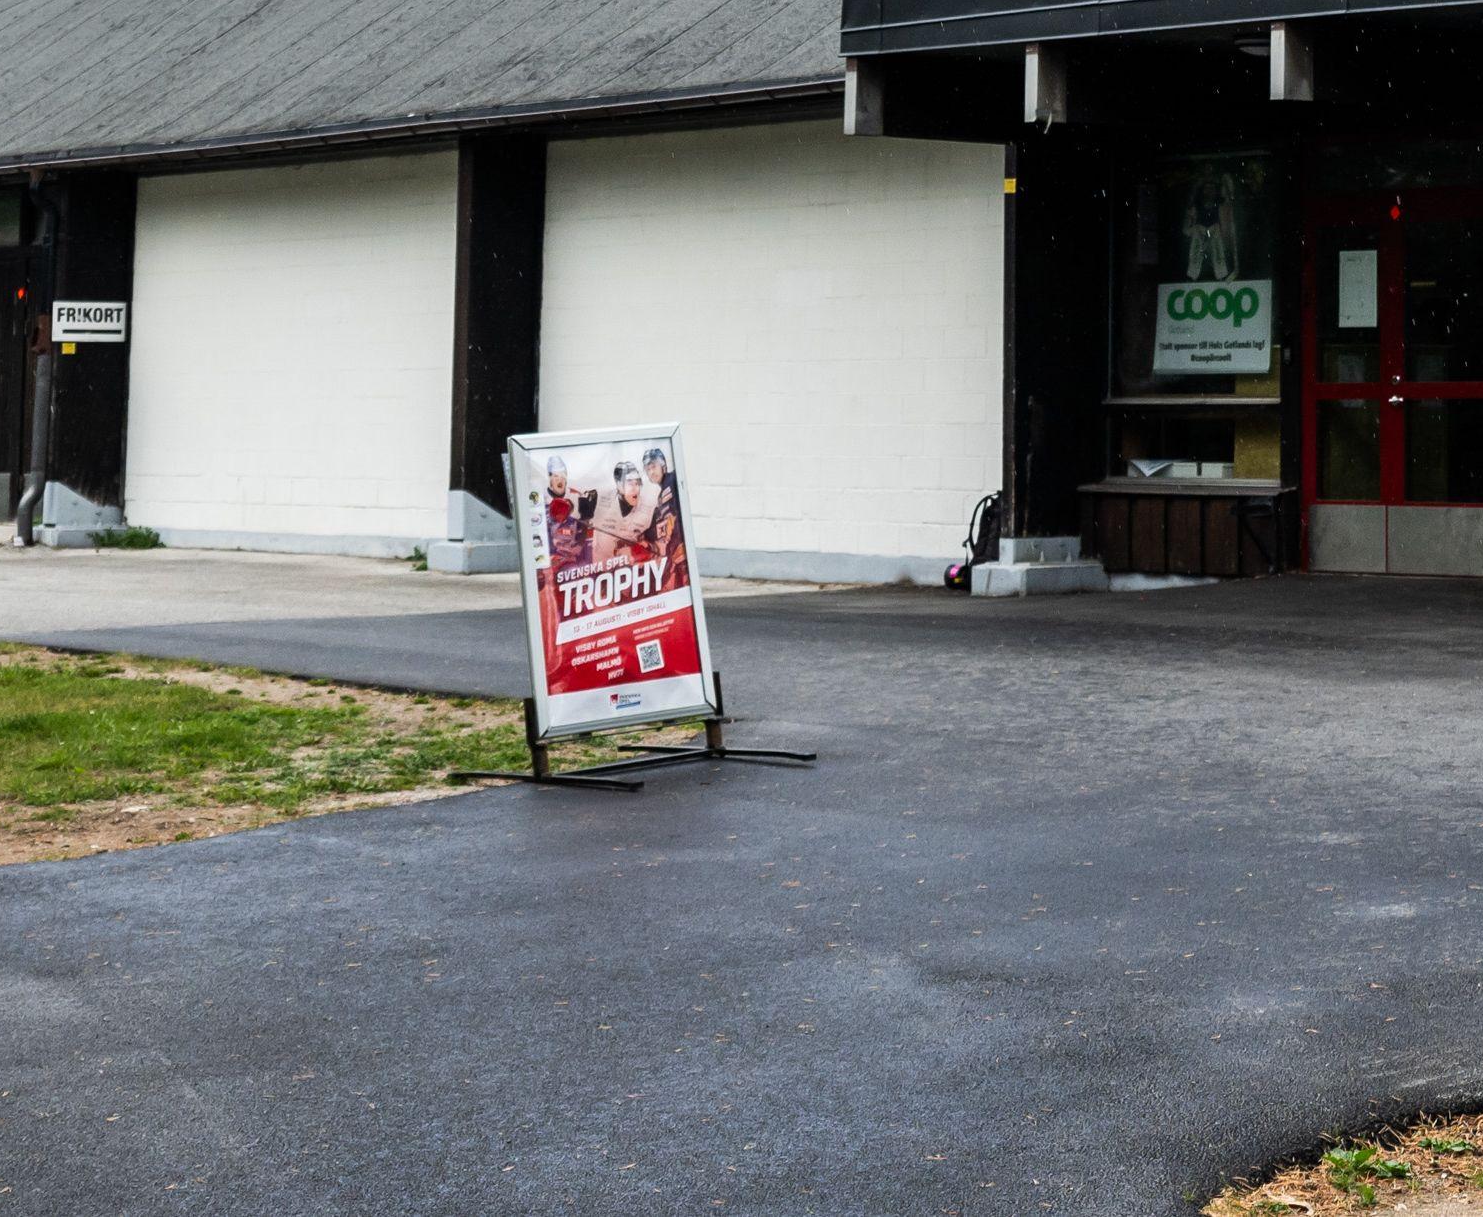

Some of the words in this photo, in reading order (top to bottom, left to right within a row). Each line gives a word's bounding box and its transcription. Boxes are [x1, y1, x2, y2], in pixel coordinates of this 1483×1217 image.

[1167, 287, 1259, 328] coop
[557, 562, 604, 583] SVENSKA
[606, 554, 630, 570] SPEL
[559, 557, 668, 617] TROPHY
[576, 641, 597, 654] VISBY
